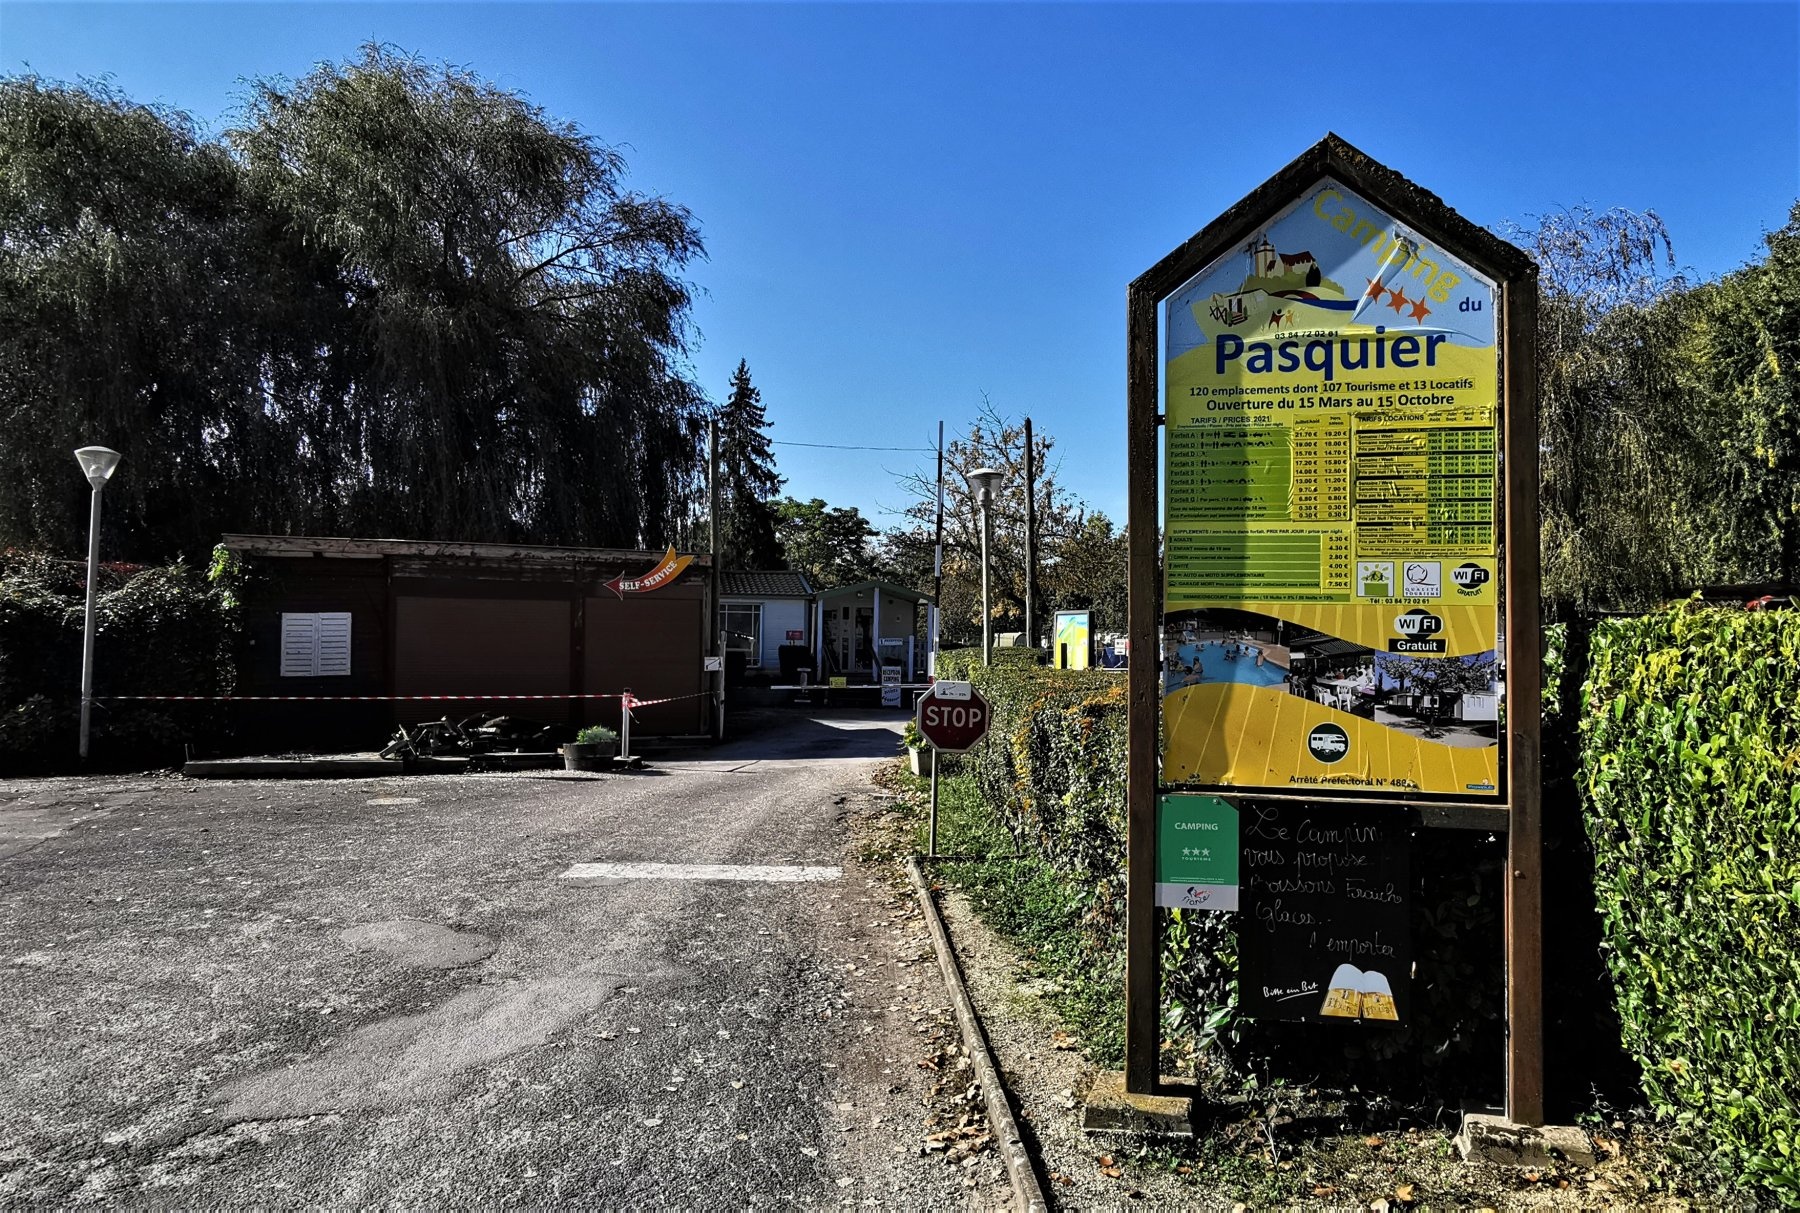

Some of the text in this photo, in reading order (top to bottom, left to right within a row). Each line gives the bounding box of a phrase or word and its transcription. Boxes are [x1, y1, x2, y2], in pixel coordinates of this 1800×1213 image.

[1314, 190, 1461, 303] Camping
[1459, 297, 1482, 312] du
[1216, 326, 1446, 381] Pasquier
[1190, 387, 1208, 396] 120
[1212, 386, 1290, 397] emplacements
[1293, 384, 1318, 393] dont
[1323, 383, 1342, 392] 107
[1345, 382, 1395, 391] Tourisme
[1414, 380, 1426, 390] 13
[1430, 379, 1473, 389] Locatifs
[1207, 394, 1454, 410] Ouverture du 15 Mars au 15 Octobre
[619, 560, 678, 590] SELF-SERVICE
[1457, 588, 1482, 597] GRATUIT
[1399, 619, 1435, 629] WI FI
[1397, 641, 1437, 650] Gratuit
[926, 706, 982, 728] STOP
[1289, 776, 1318, 784] Arrêté
[1174, 822, 1218, 830] CAMPING
[1245, 805, 1382, 856] Le Campin
[1244, 848, 1368, 878] vous propose
[1182, 892, 1210, 905] France
[1326, 931, 1397, 961] emporter
[1263, 986, 1283, 998] Bitte
